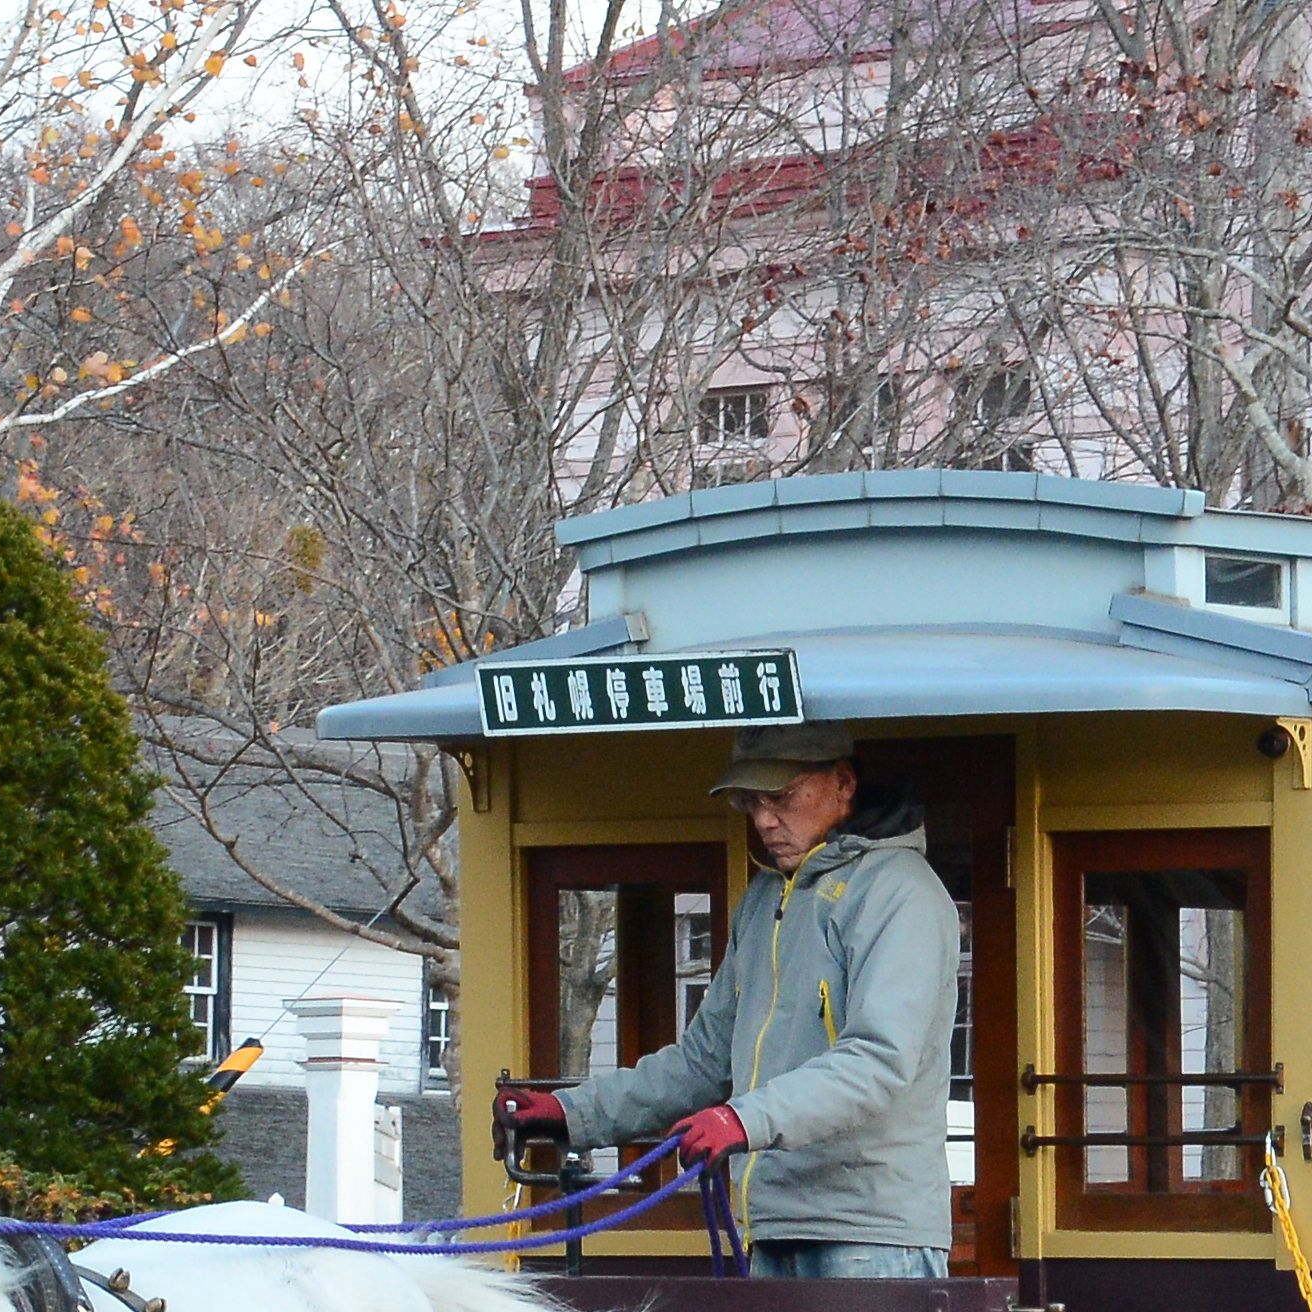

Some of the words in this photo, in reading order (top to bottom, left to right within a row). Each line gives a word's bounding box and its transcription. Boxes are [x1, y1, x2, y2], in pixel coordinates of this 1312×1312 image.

[492, 661, 781, 723] 旧札幌停車場前行
